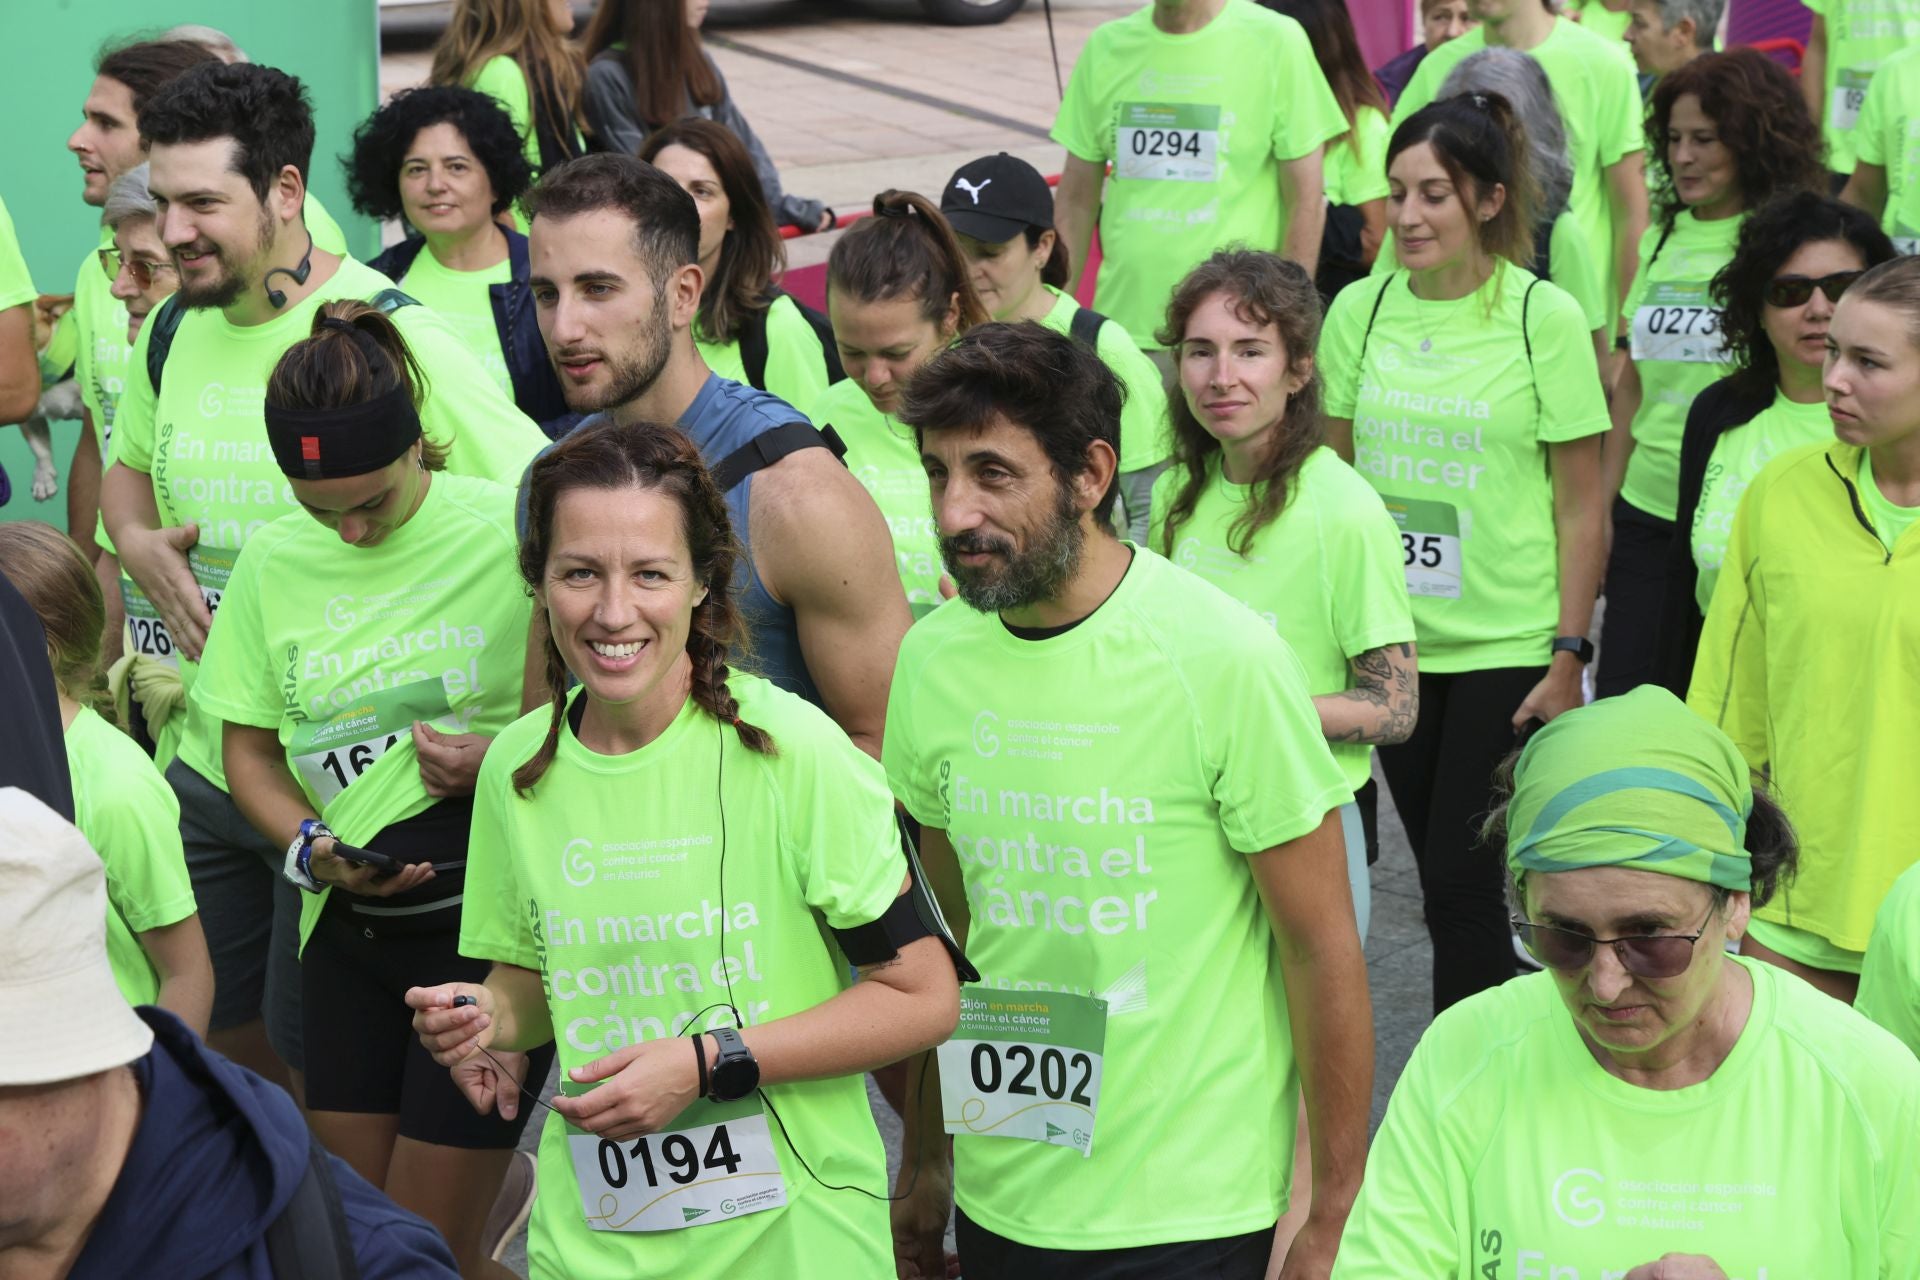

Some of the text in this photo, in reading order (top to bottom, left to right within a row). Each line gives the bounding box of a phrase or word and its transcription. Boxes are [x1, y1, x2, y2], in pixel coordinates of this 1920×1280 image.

[1132, 130, 1201, 157] 0294
[1648, 308, 1718, 335] 0273
[1384, 389, 1490, 419] marcha
[173, 431, 206, 461] En
[1451, 425, 1485, 453] el
[1357, 443, 1486, 492] cáncer
[172, 472, 277, 505] contra
[1400, 533, 1442, 568] 35
[130, 618, 175, 656] 026
[303, 620, 485, 681] En marcha
[442, 656, 482, 696] el
[335, 722, 345, 732] el
[346, 715, 377, 729] cáncer
[1065, 723, 1120, 735] española
[322, 734, 398, 789] 16
[955, 774, 1156, 825] En marcha
[602, 834, 712, 853] asociación española
[957, 832, 1153, 881] contra el
[602, 855, 636, 868] contra
[602, 868, 661, 882] en Asturias
[545, 898, 760, 947] En marcha
[551, 938, 765, 1002] contra el
[960, 999, 1049, 1014] Gijón en marcha
[960, 1012, 1051, 1026] contra el cáncer
[970, 1042, 1092, 1107] 0202
[598, 1124, 742, 1189] 0194
[1480, 1228, 1502, 1280] AS
